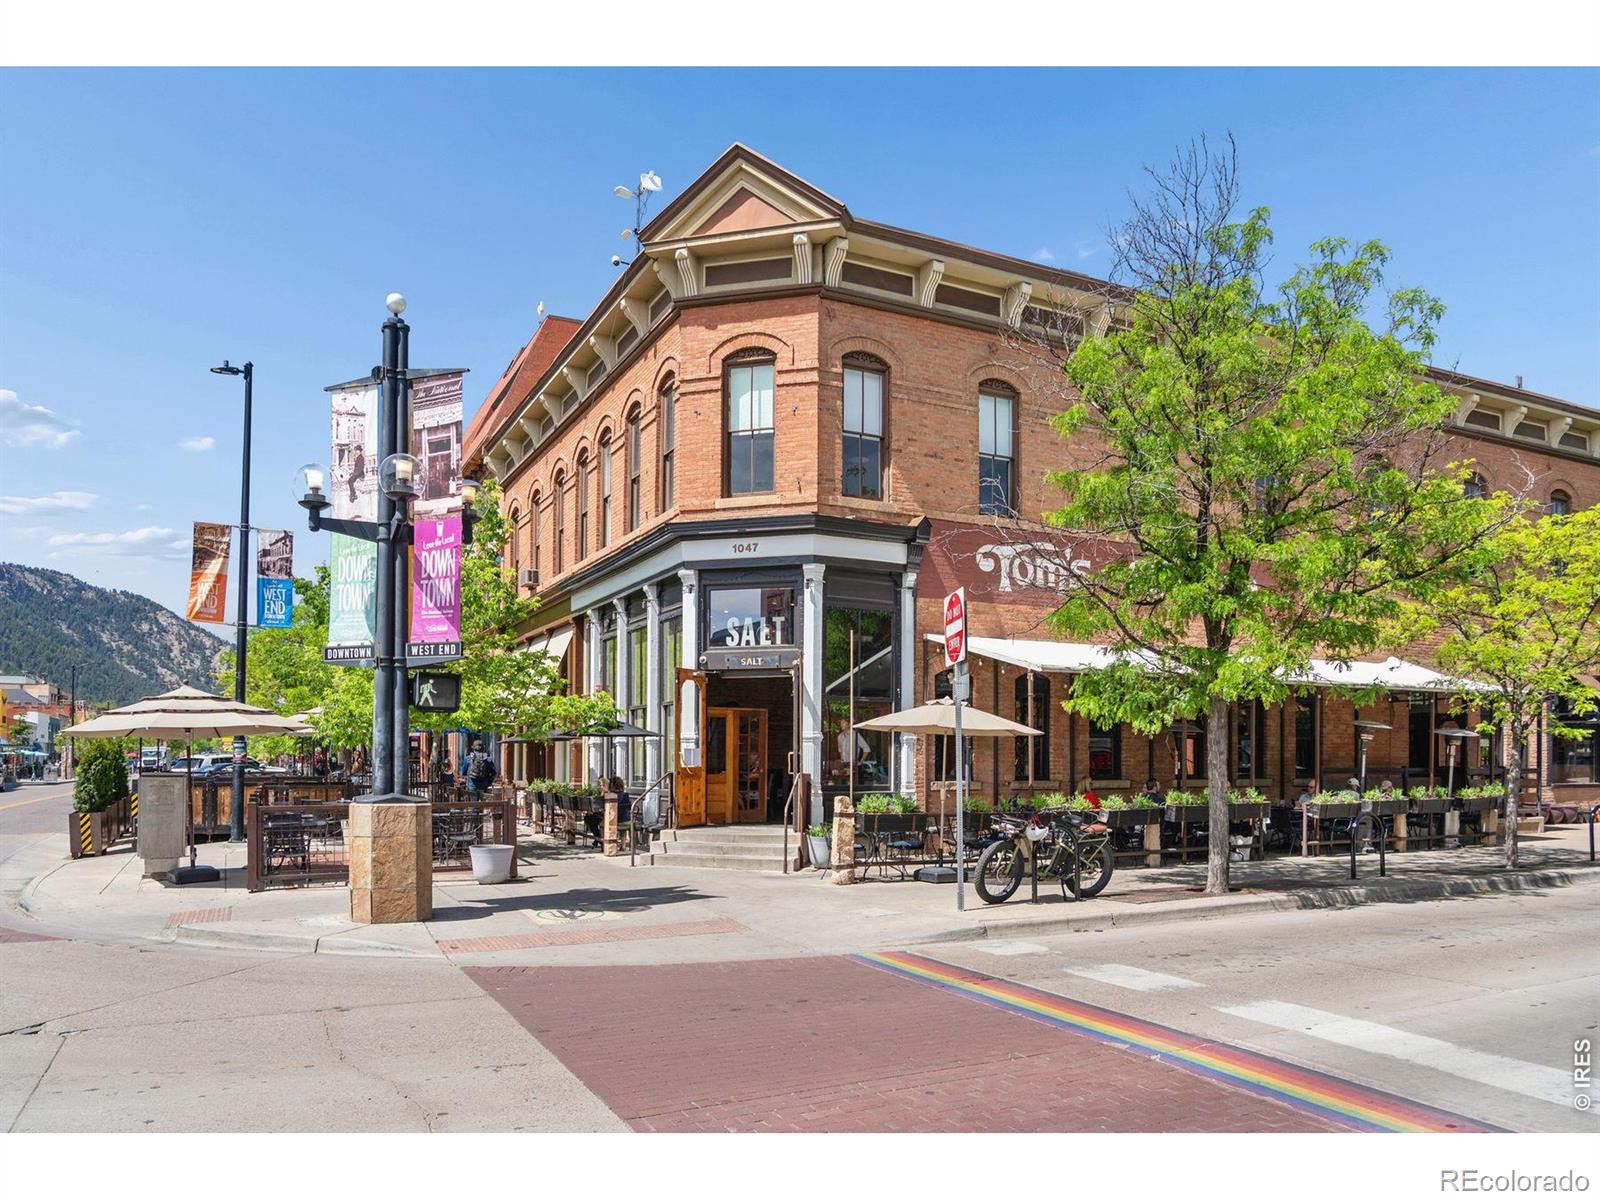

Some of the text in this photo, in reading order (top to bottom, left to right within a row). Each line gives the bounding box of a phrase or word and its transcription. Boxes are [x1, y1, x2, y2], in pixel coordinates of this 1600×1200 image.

[732, 542, 759, 553] 1047
[337, 554, 371, 581] DOWN
[421, 548, 456, 578] DOWN
[198, 582, 221, 596] WEST
[263, 587, 287, 601] WEST
[337, 582, 371, 610] TOWN
[420, 577, 456, 608] TOWN
[264, 600, 286, 615] END
[725, 617, 785, 647] SALT
[327, 647, 372, 659] DOWNTOWN
[411, 644, 456, 656] WEST END
[740, 657, 762, 666] SALT
